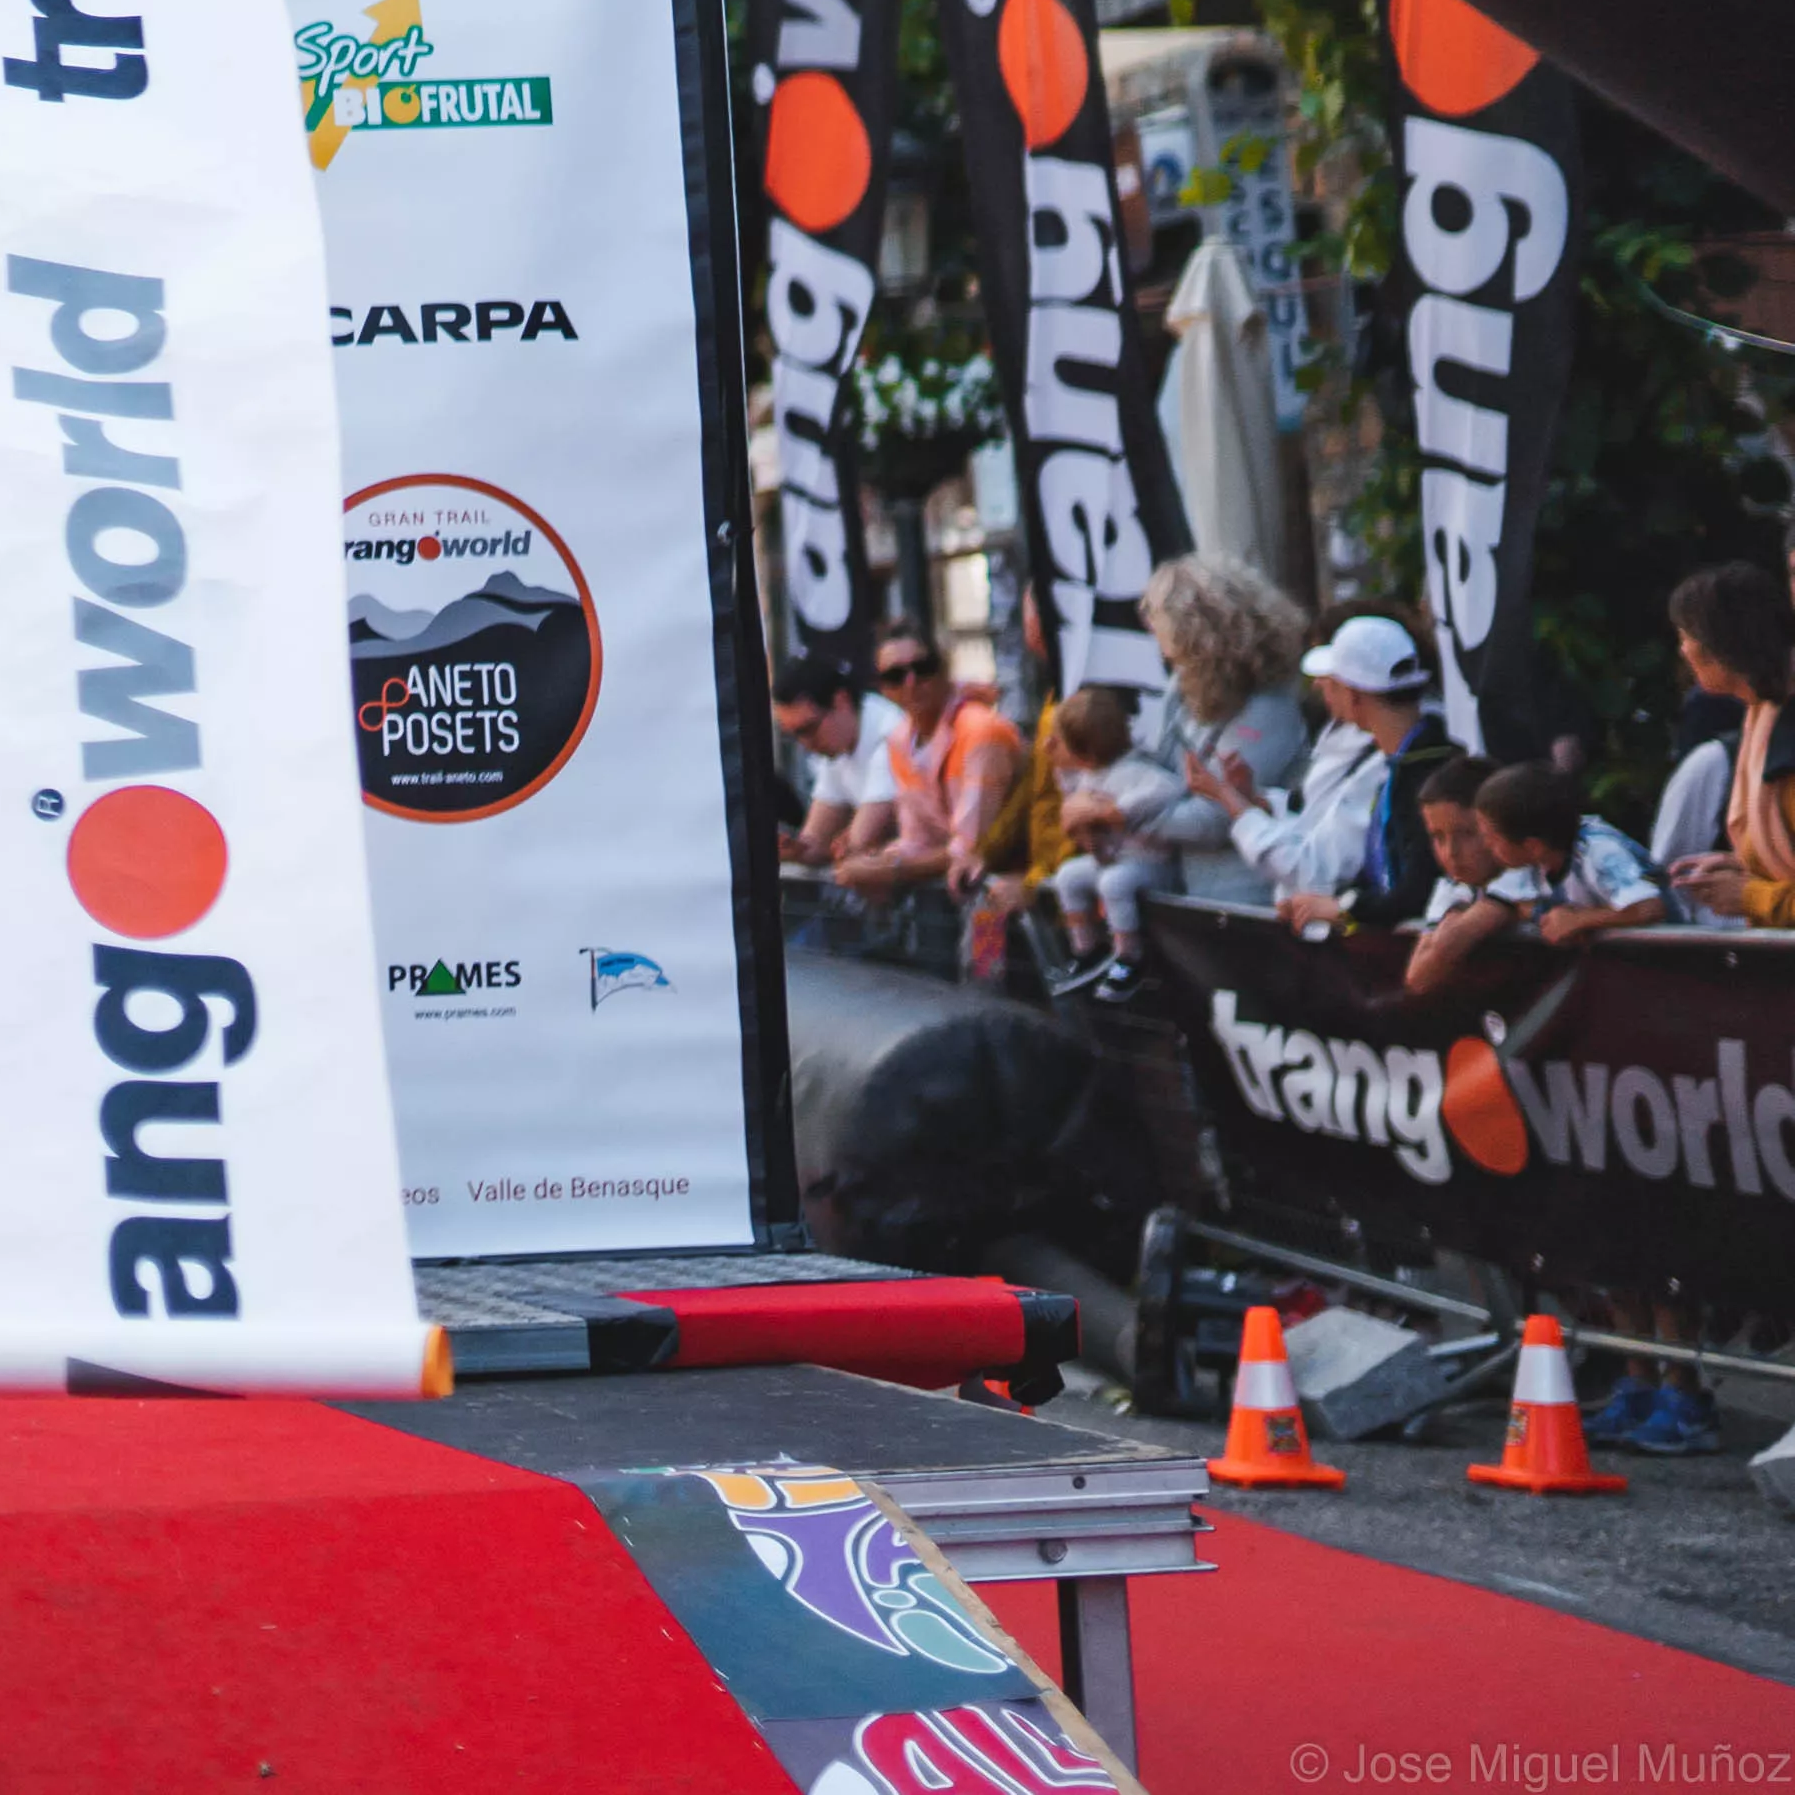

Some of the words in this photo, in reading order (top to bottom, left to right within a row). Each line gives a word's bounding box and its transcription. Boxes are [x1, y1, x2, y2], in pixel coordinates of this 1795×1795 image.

[295, 21, 433, 97] Sport
[333, 83, 541, 126] BIOFRUTAL
[329, 301, 579, 346] CARPA
[369, 511, 425, 527] GRAN
[435, 510, 492, 525] TRAIL
[343, 530, 531, 565] rangoworld
[407, 663, 517, 707] ANETO
[383, 710, 520, 756] POSETS
[467, 1178, 526, 1202] Valle
[534, 1177, 562, 1200] de
[571, 1176, 690, 1201] Benasque
